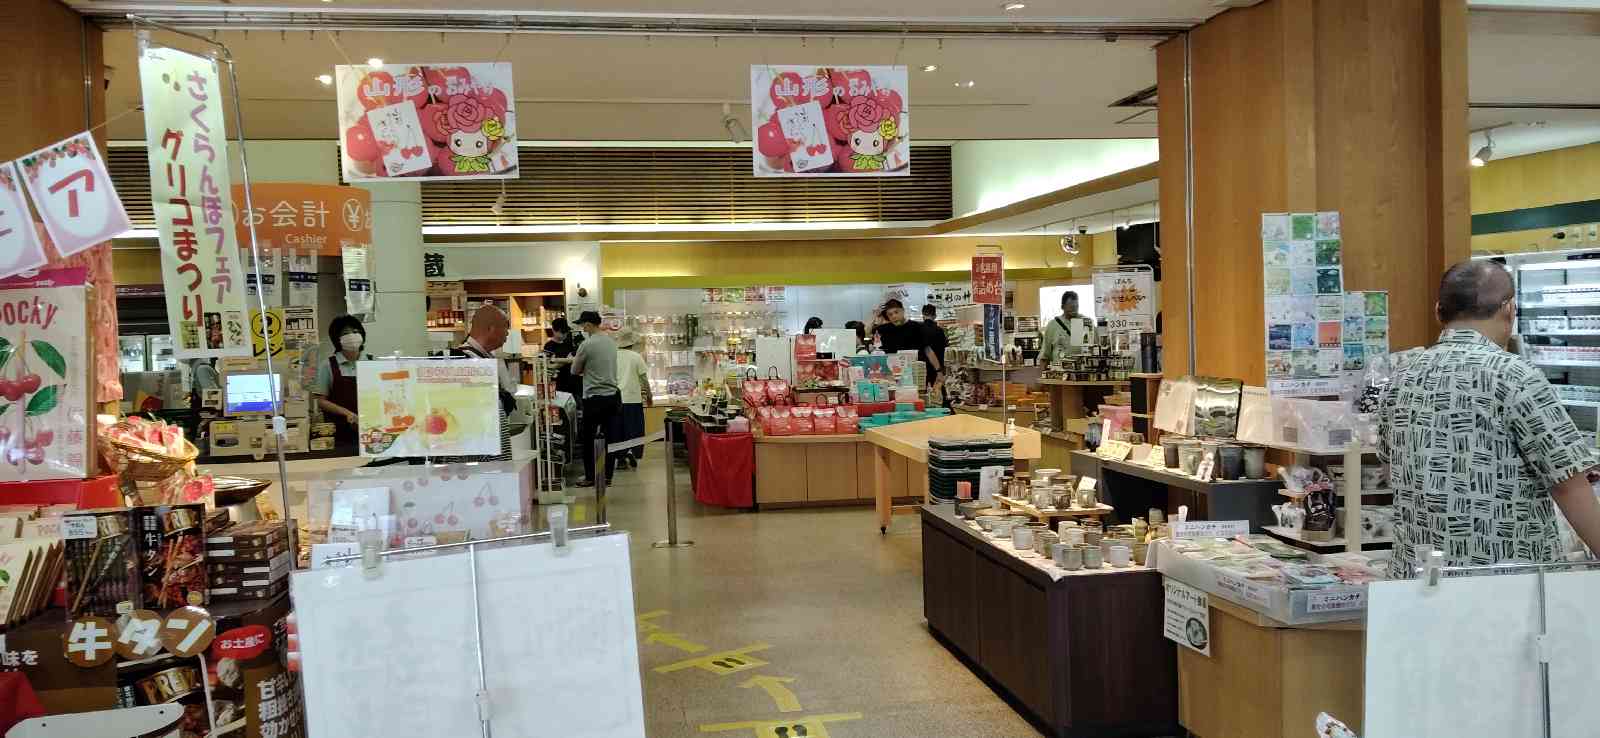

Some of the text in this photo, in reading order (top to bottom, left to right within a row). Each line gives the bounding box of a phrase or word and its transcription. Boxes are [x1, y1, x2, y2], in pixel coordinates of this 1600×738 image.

[161, 128, 204, 328] グリコまつり
[242, 200, 330, 228] お会計
[285, 233, 328, 245] Cashier
[0, 295, 58, 330] ocky
[252, 342, 284, 357] レジ
[144, 531, 159, 577] 牛タン
[68, 617, 211, 661] 牛タン
[220, 633, 264, 650] お土産に
